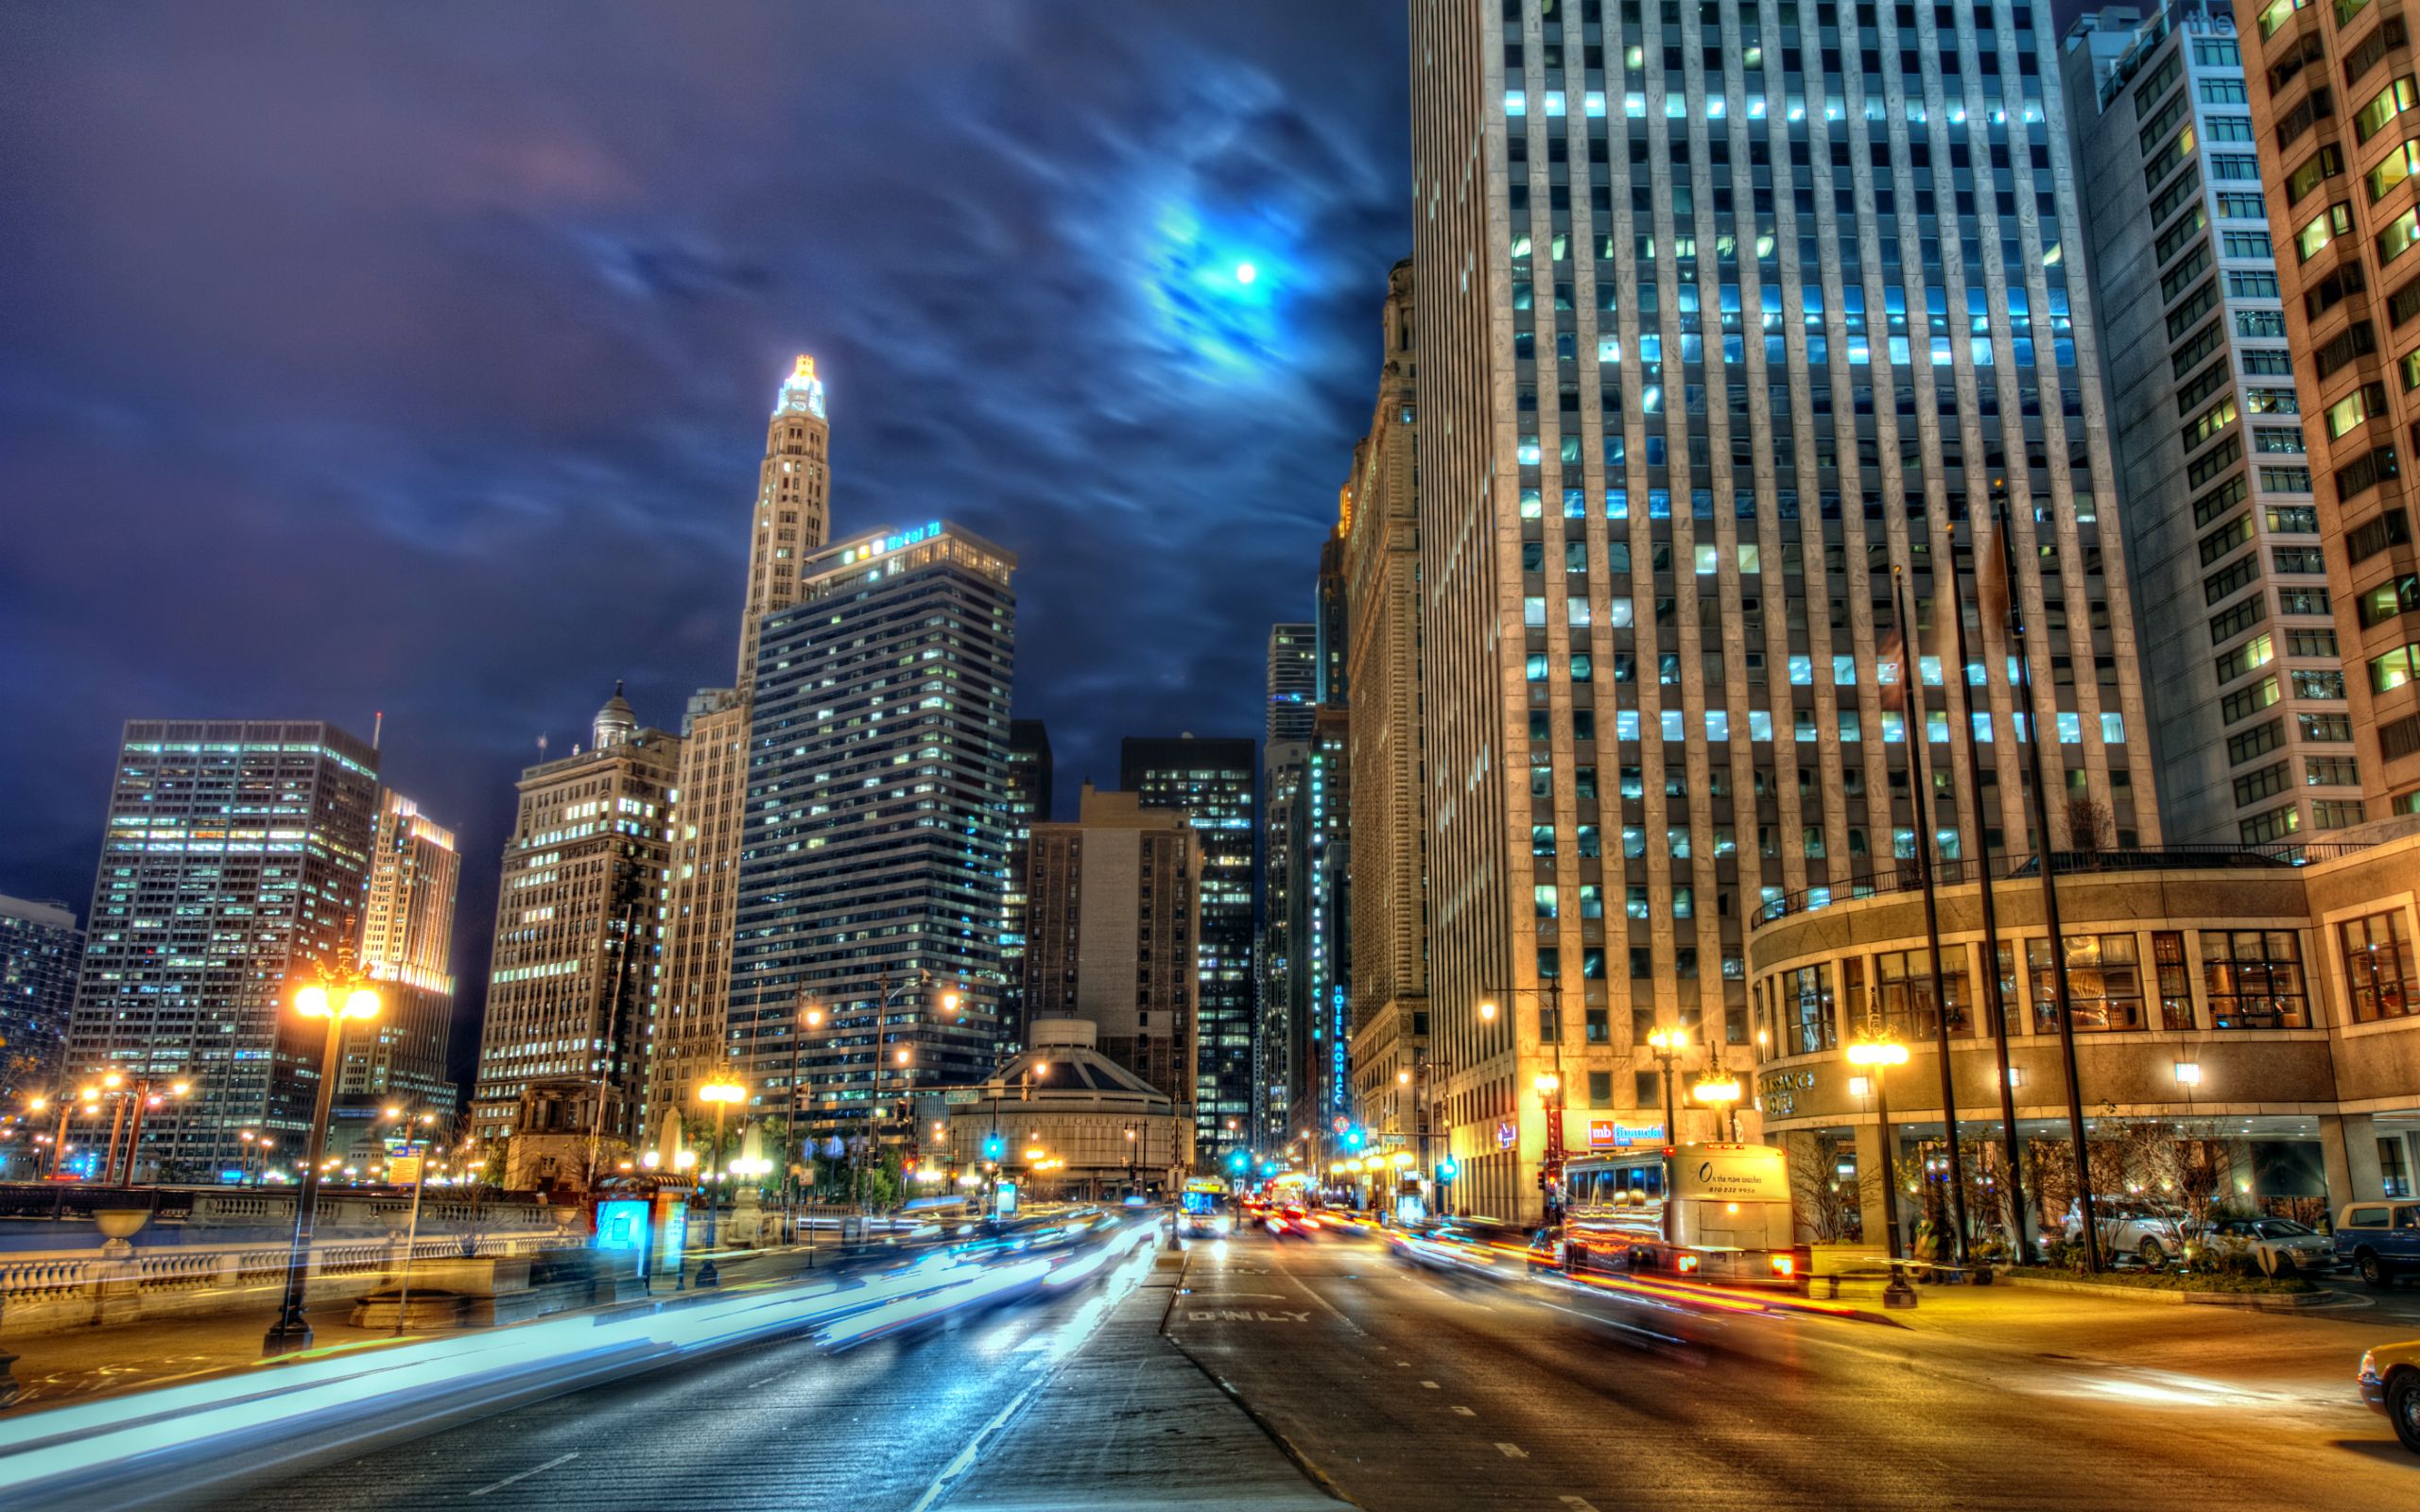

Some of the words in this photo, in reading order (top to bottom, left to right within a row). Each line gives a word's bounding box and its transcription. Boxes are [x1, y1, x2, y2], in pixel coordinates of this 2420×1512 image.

[2185, 9, 2233, 36] the
[887, 526, 925, 551] Hotel
[927, 521, 941, 538] 71
[1333, 984, 1344, 1037] HOTEL
[1592, 1124, 1612, 1139] mb
[1187, 1310, 1311, 1322] ONLY
